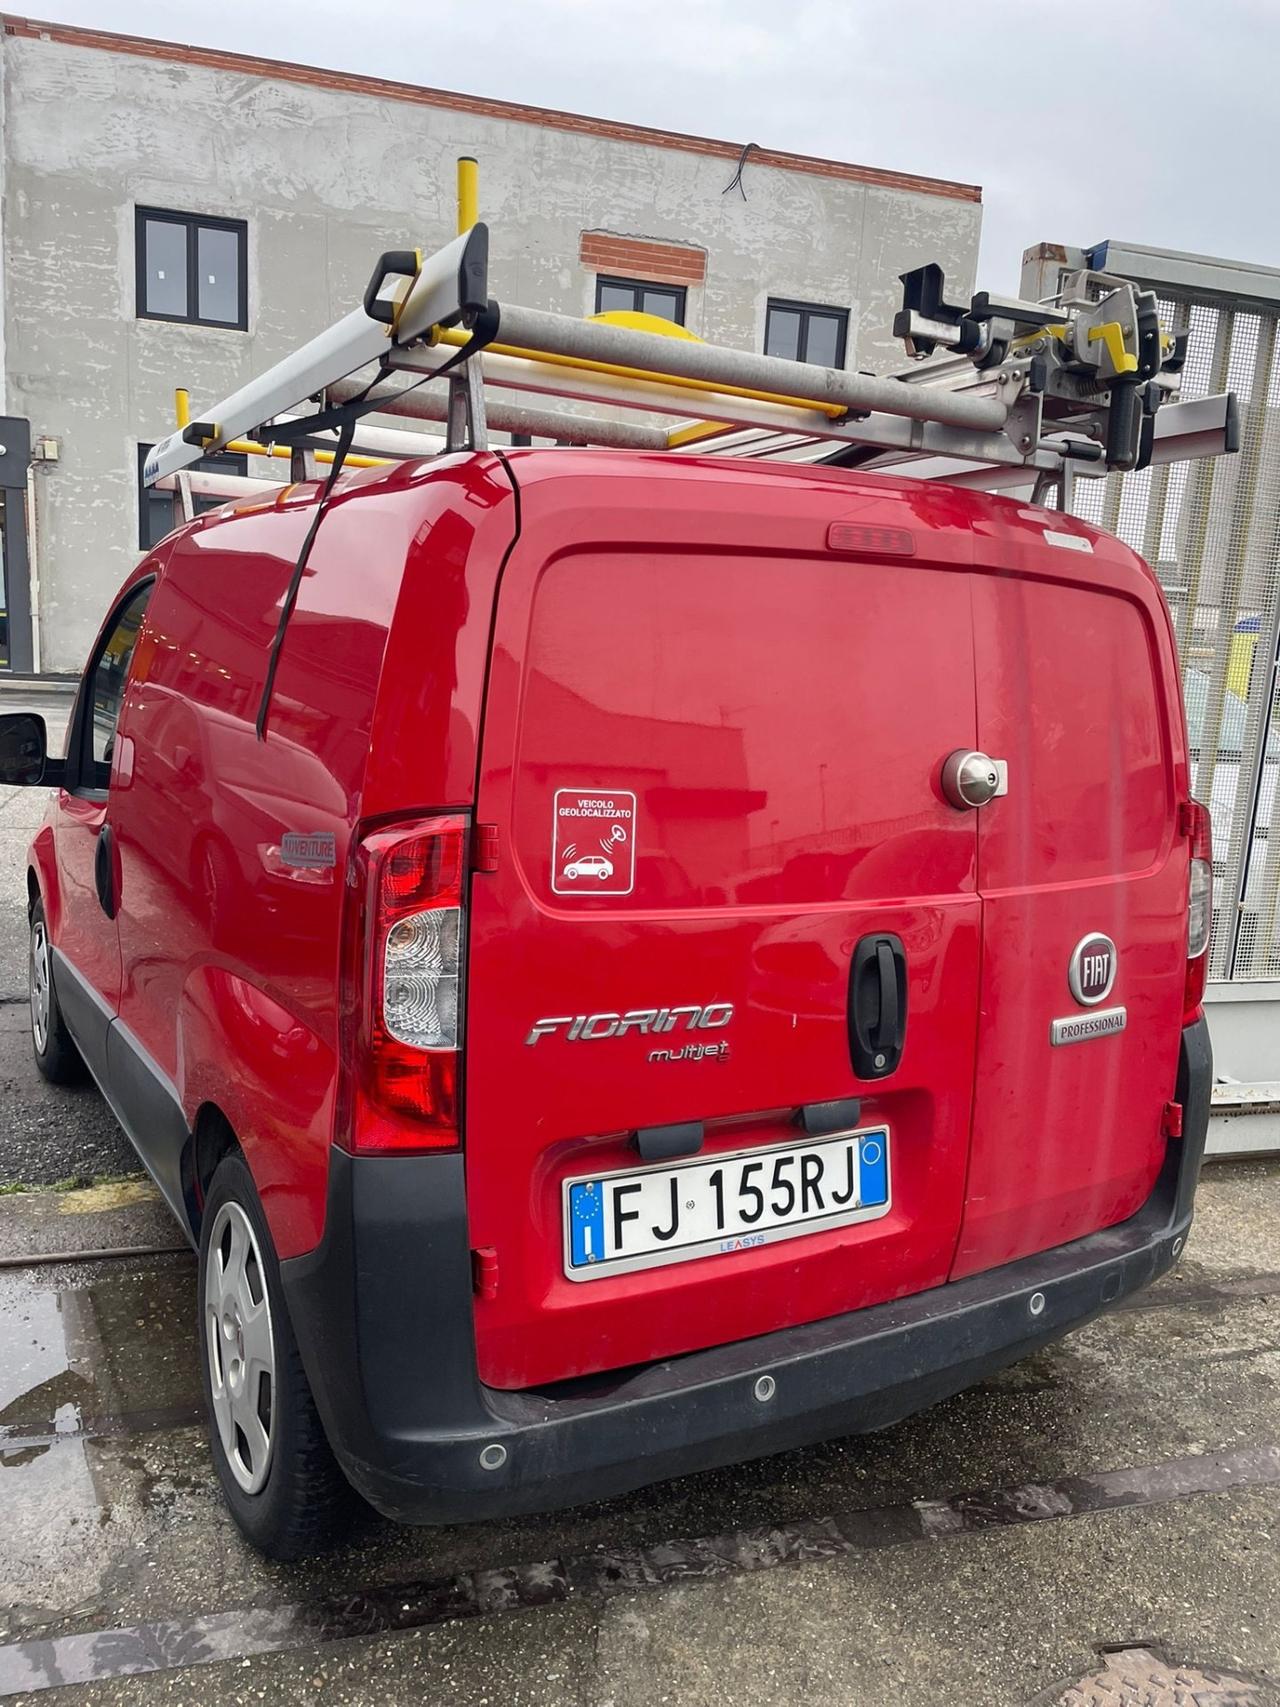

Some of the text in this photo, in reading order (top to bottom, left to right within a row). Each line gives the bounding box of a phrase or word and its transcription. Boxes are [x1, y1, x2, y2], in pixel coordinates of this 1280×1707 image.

[558, 807, 632, 818] GEOLOCALIZZATO
[577, 799, 614, 809] VEICOLO
[1083, 953, 1109, 988] FIAT
[1061, 1015, 1124, 1039] PROFESSIONAL
[648, 1041, 730, 1063] multijet
[613, 1177, 680, 1250] FJ
[720, 1234, 765, 1252] LEASYS
